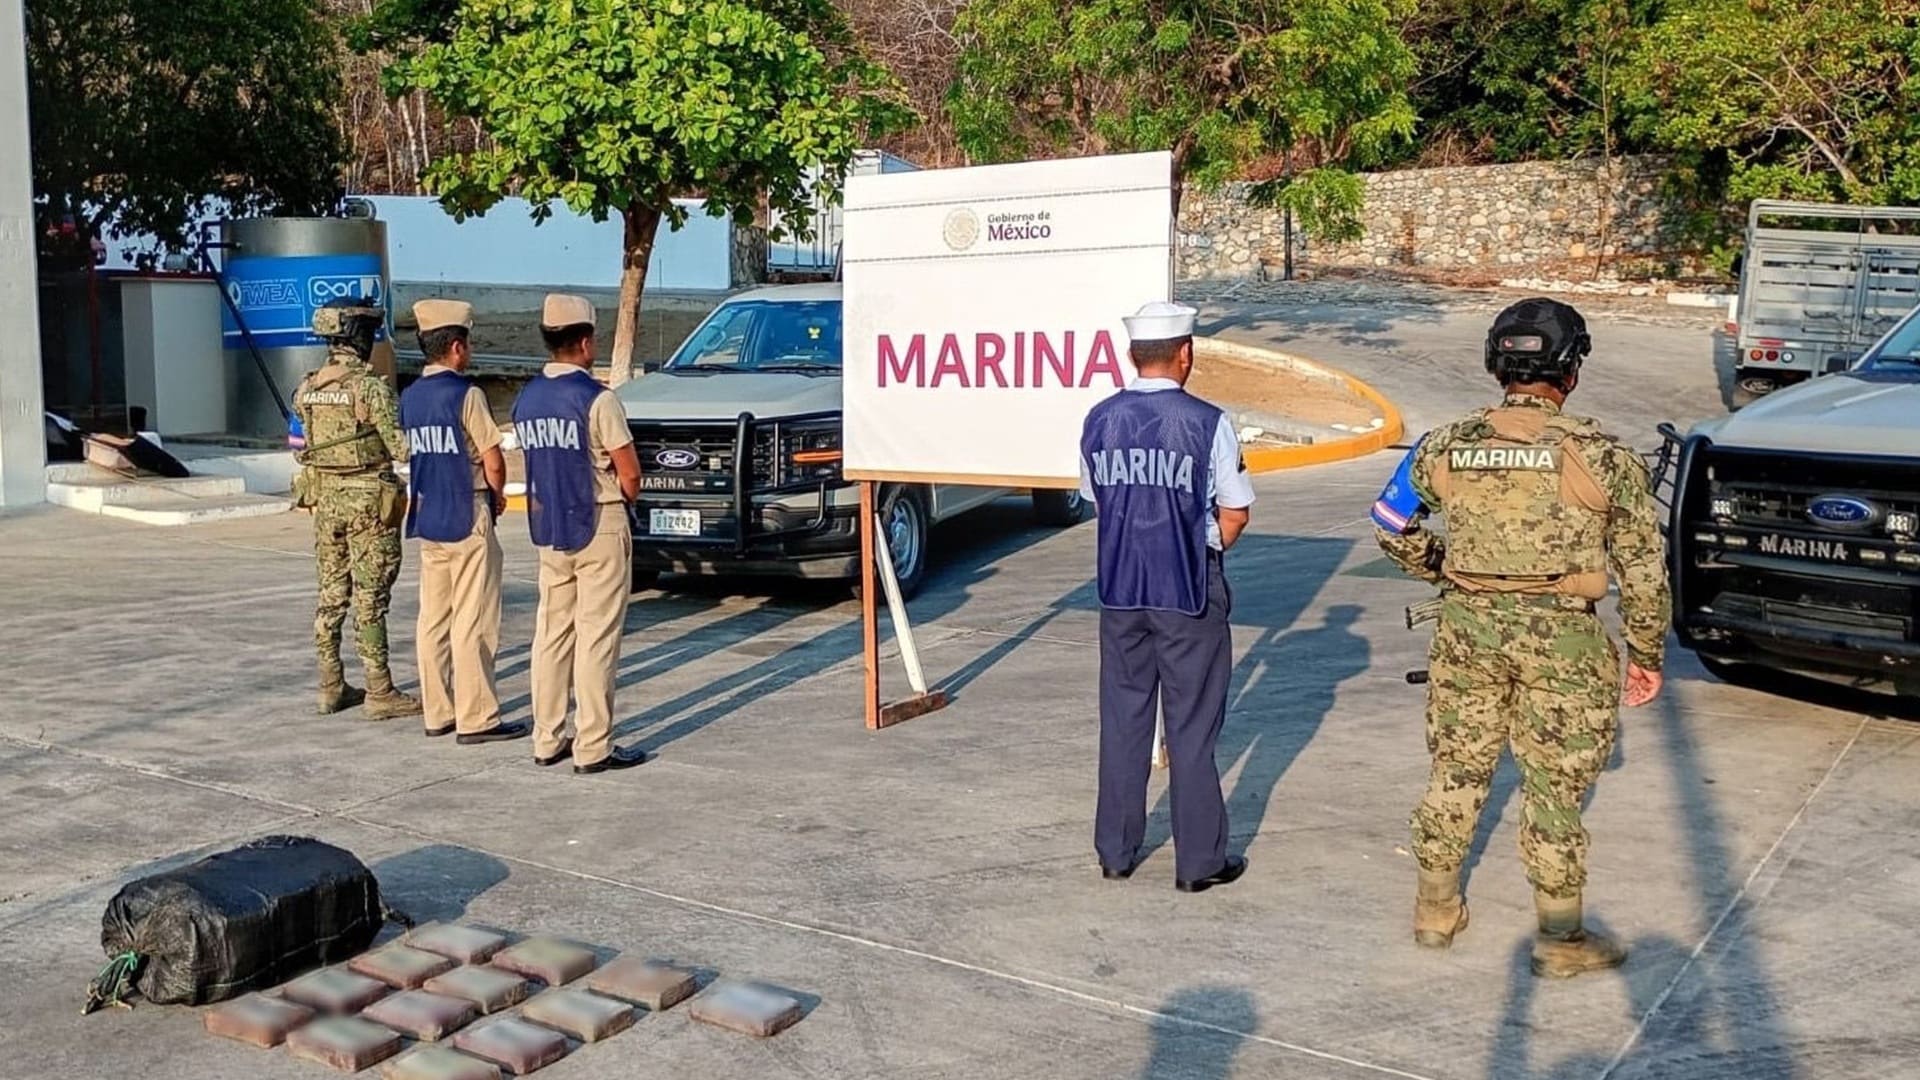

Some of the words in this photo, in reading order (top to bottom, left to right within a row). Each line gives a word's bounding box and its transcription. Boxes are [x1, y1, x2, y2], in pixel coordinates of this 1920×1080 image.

[987, 211, 1035, 223] Gobierno
[1038, 210, 1050, 220] de
[988, 221, 1051, 241] México
[877, 330, 1125, 388] MARINA
[1451, 449, 1555, 469] MARINA
[1092, 448, 1193, 493] MARINA
[1819, 503, 1854, 519] Ford
[1760, 534, 1847, 560] MARINA
